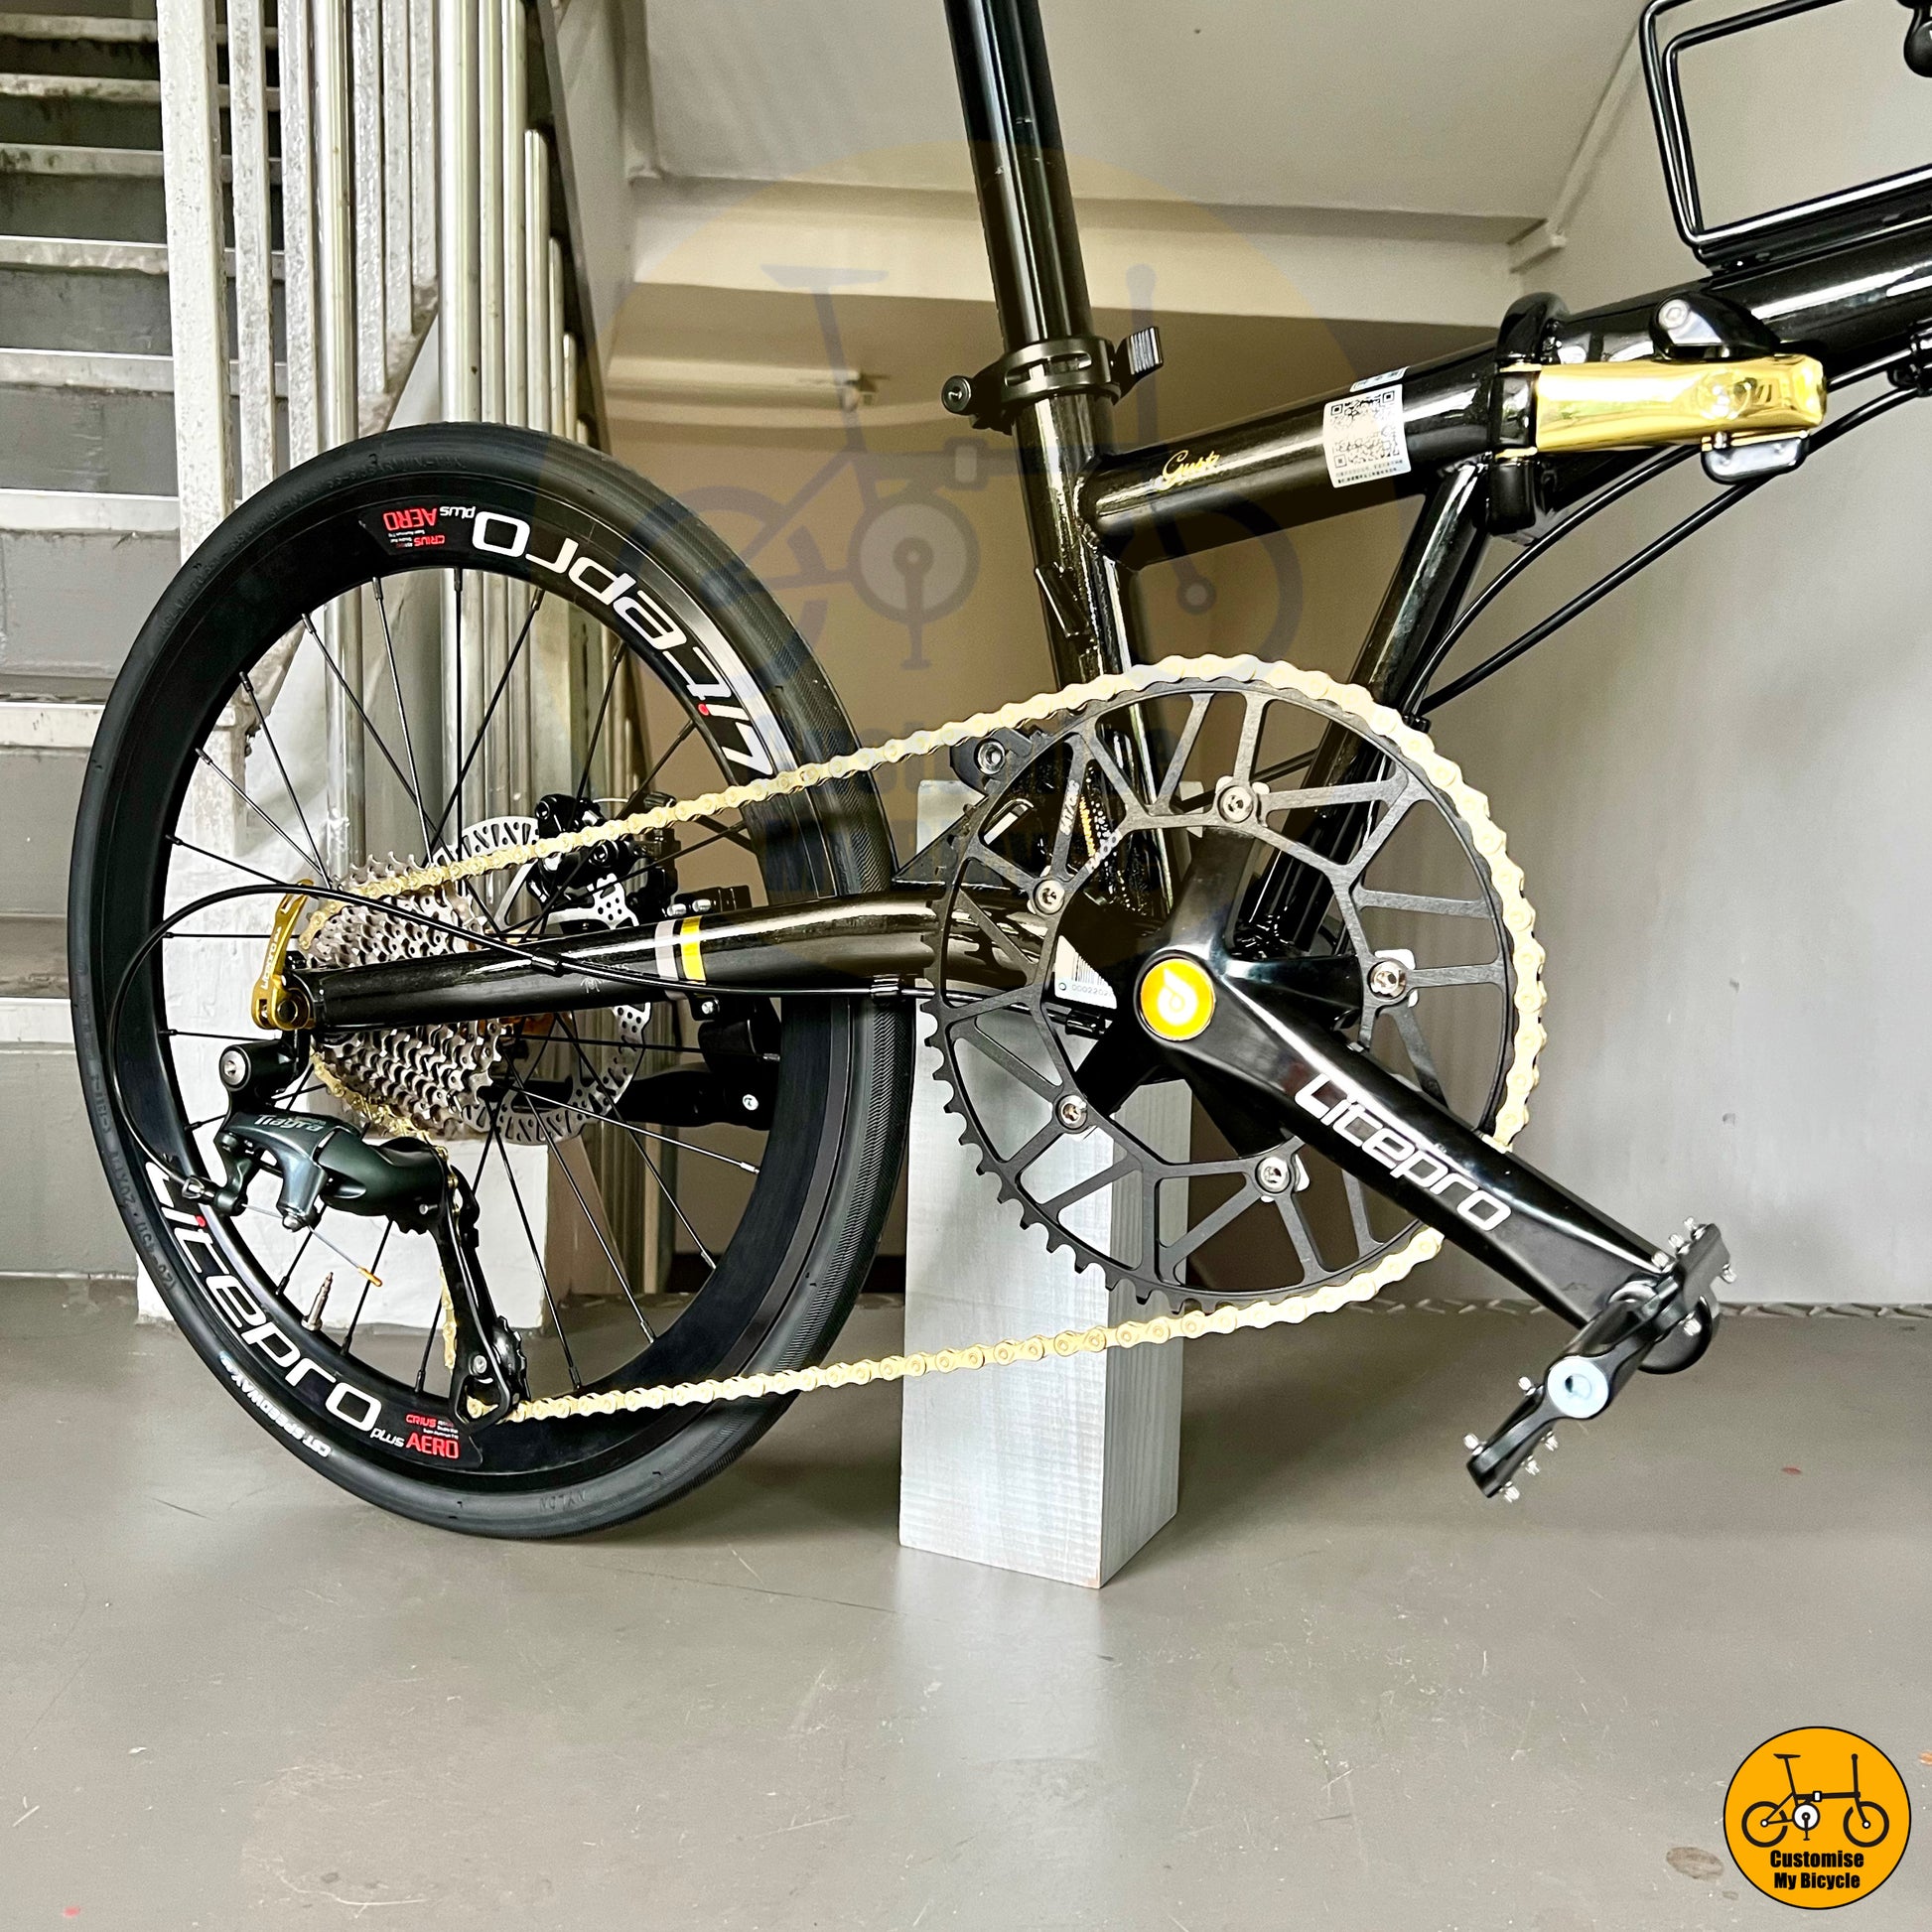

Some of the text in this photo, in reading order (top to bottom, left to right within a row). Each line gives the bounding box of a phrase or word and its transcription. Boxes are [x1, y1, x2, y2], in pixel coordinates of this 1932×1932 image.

[382, 507, 438, 531] AERO
[439, 505, 477, 519] plus
[413, 534, 446, 547] CRIUS
[472, 510, 773, 775] Litepro
[254, 1114, 325, 1132] Tiagra
[1294, 1072, 1511, 1231] Litepro
[145, 1161, 405, 1448] Litepro plus
[230, 1374, 332, 1457] CST SPEEDWAY
[405, 1414, 437, 1428] CRIUS
[405, 1432, 460, 1459] AERO
